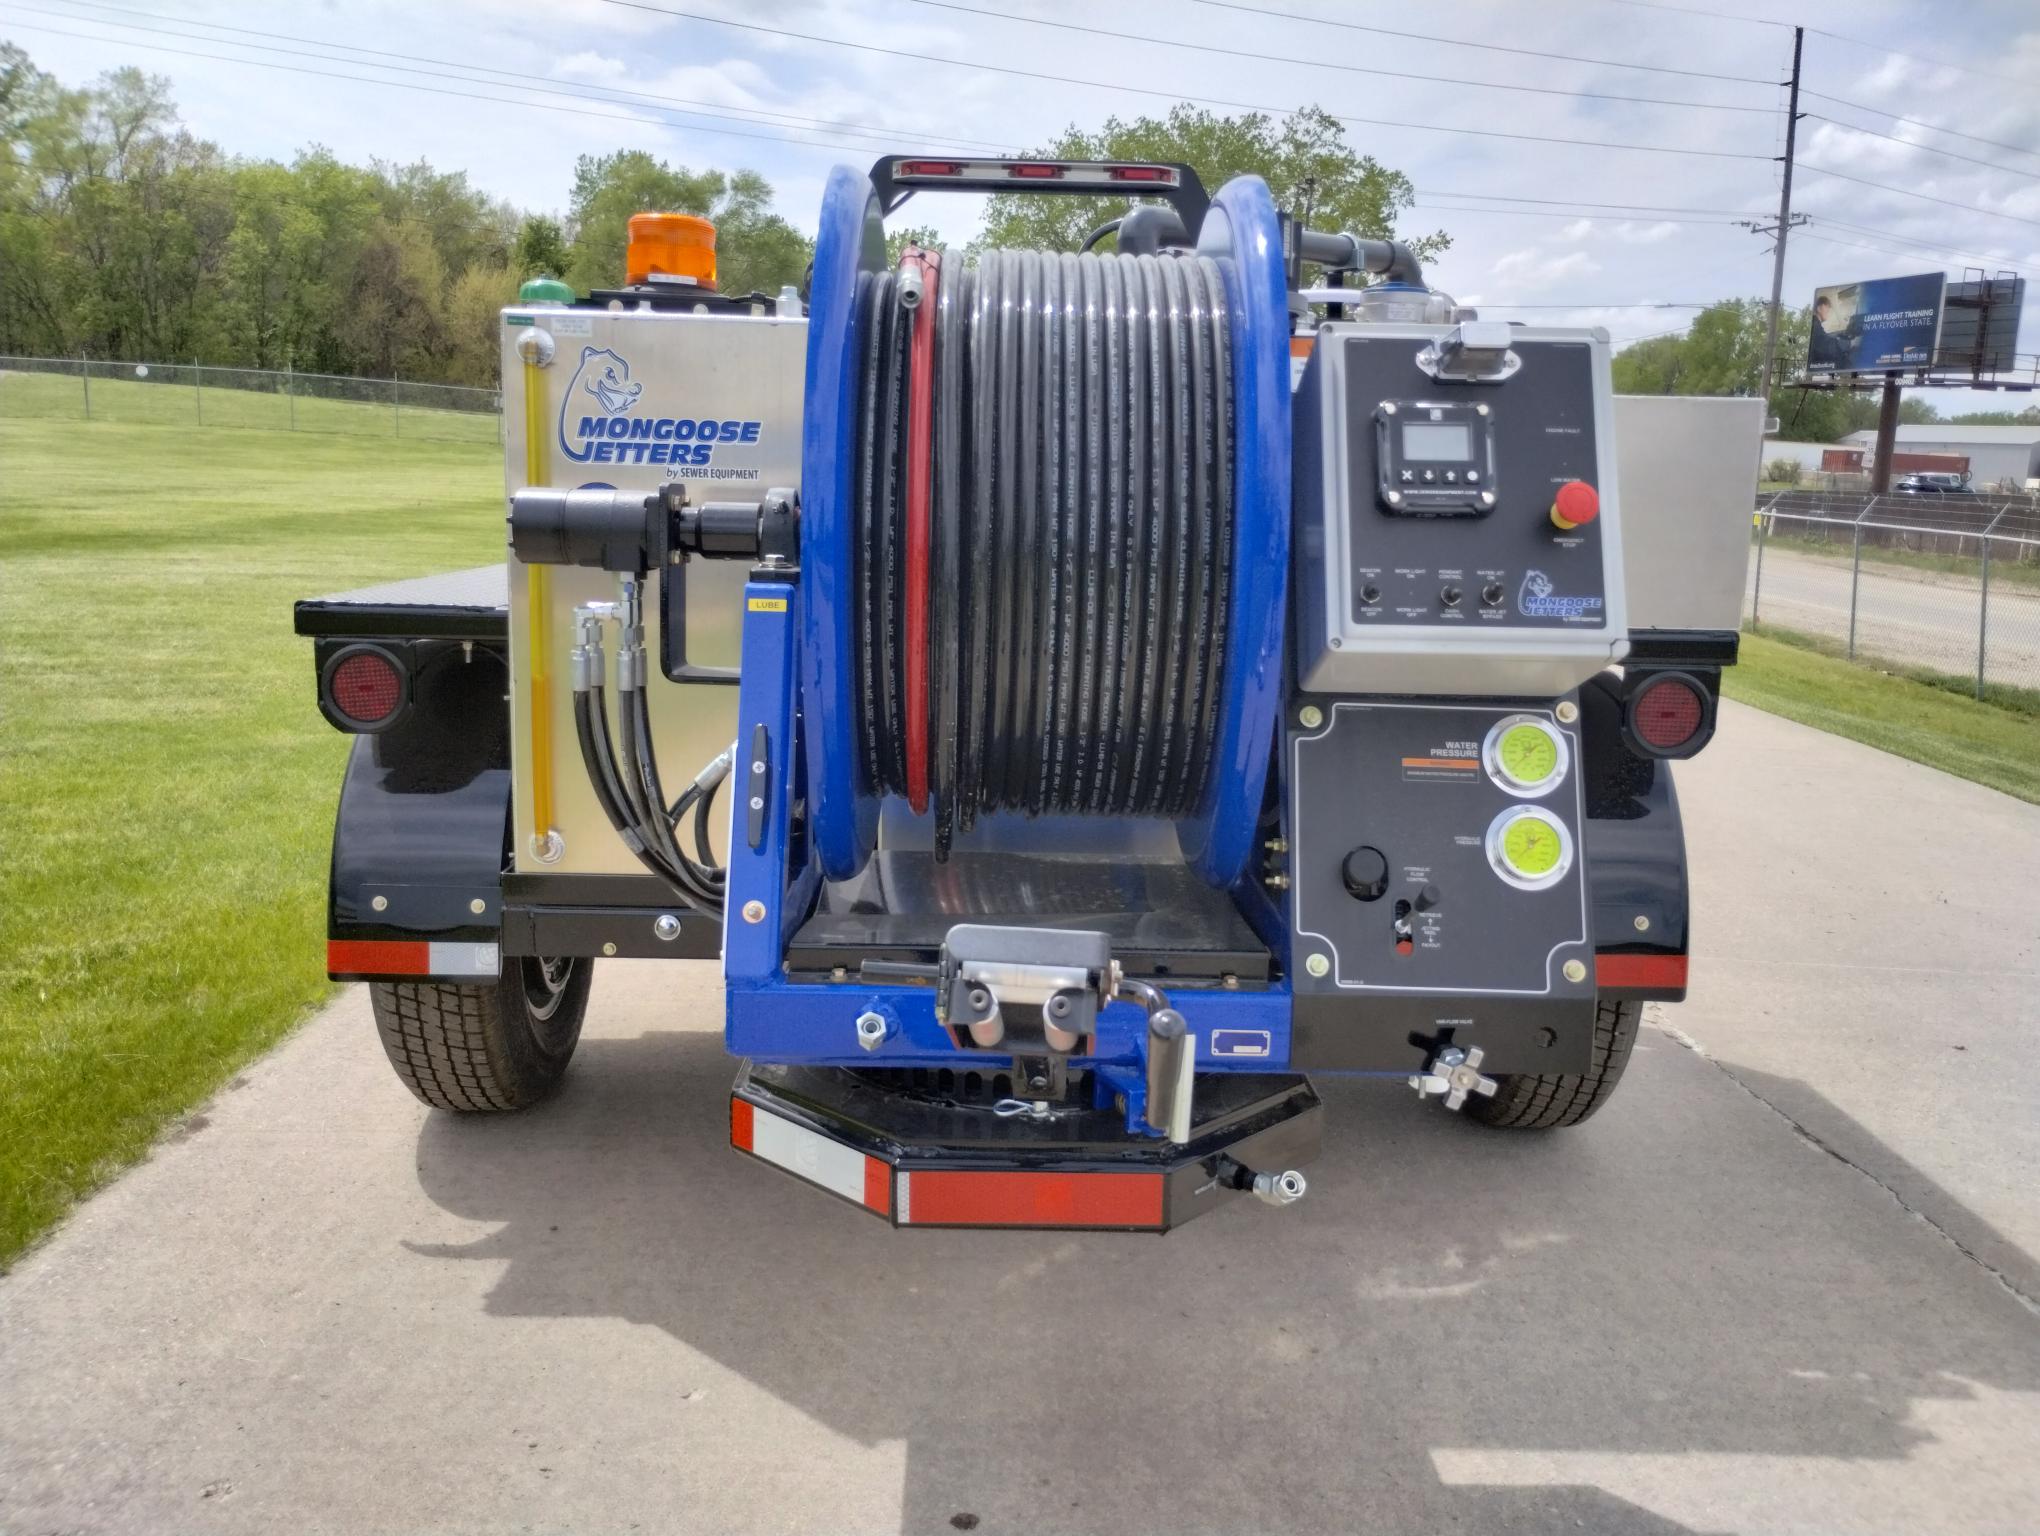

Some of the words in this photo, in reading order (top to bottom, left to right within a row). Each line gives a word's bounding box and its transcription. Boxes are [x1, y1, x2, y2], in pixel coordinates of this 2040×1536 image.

[1879, 320, 1908, 329] FLYOVER
[1883, 312, 1904, 320] FLIGHT
[1905, 309, 1933, 318] TRAINING
[577, 416, 762, 443] MONGOOSE
[566, 441, 714, 467] JETTERS
[666, 468, 680, 481] by
[681, 468, 709, 479] SEWER
[709, 468, 760, 481] EQUIPMENT
[1066, 456, 1076, 509] CLEANING
[1089, 468, 1098, 496] HOSE
[1127, 474, 1136, 495] USE
[864, 501, 872, 529] HOSE
[1109, 497, 1118, 524] MADE
[1126, 499, 1135, 528] ONLY
[1152, 497, 1160, 513] WP
[1088, 500, 1098, 553] PRODUCTS
[1151, 516, 1160, 545] 4000
[1150, 547, 1159, 568] PSI
[1176, 539, 1188, 593] CLEANING
[1049, 567, 1058, 602] WATER
[756, 601, 781, 609] LUBE
[1525, 606, 1583, 616] JETTERS
[1526, 597, 1602, 608] MONGOOSE
[1048, 605, 1057, 626] USE
[1062, 632, 1071, 657] 4000
[1061, 660, 1070, 677] PSI
[1081, 654, 1092, 700] CLEANING
[1080, 702, 1090, 724] HOSE
[1430, 749, 1479, 758] PRESSURE
[1445, 741, 1478, 750] WATER
